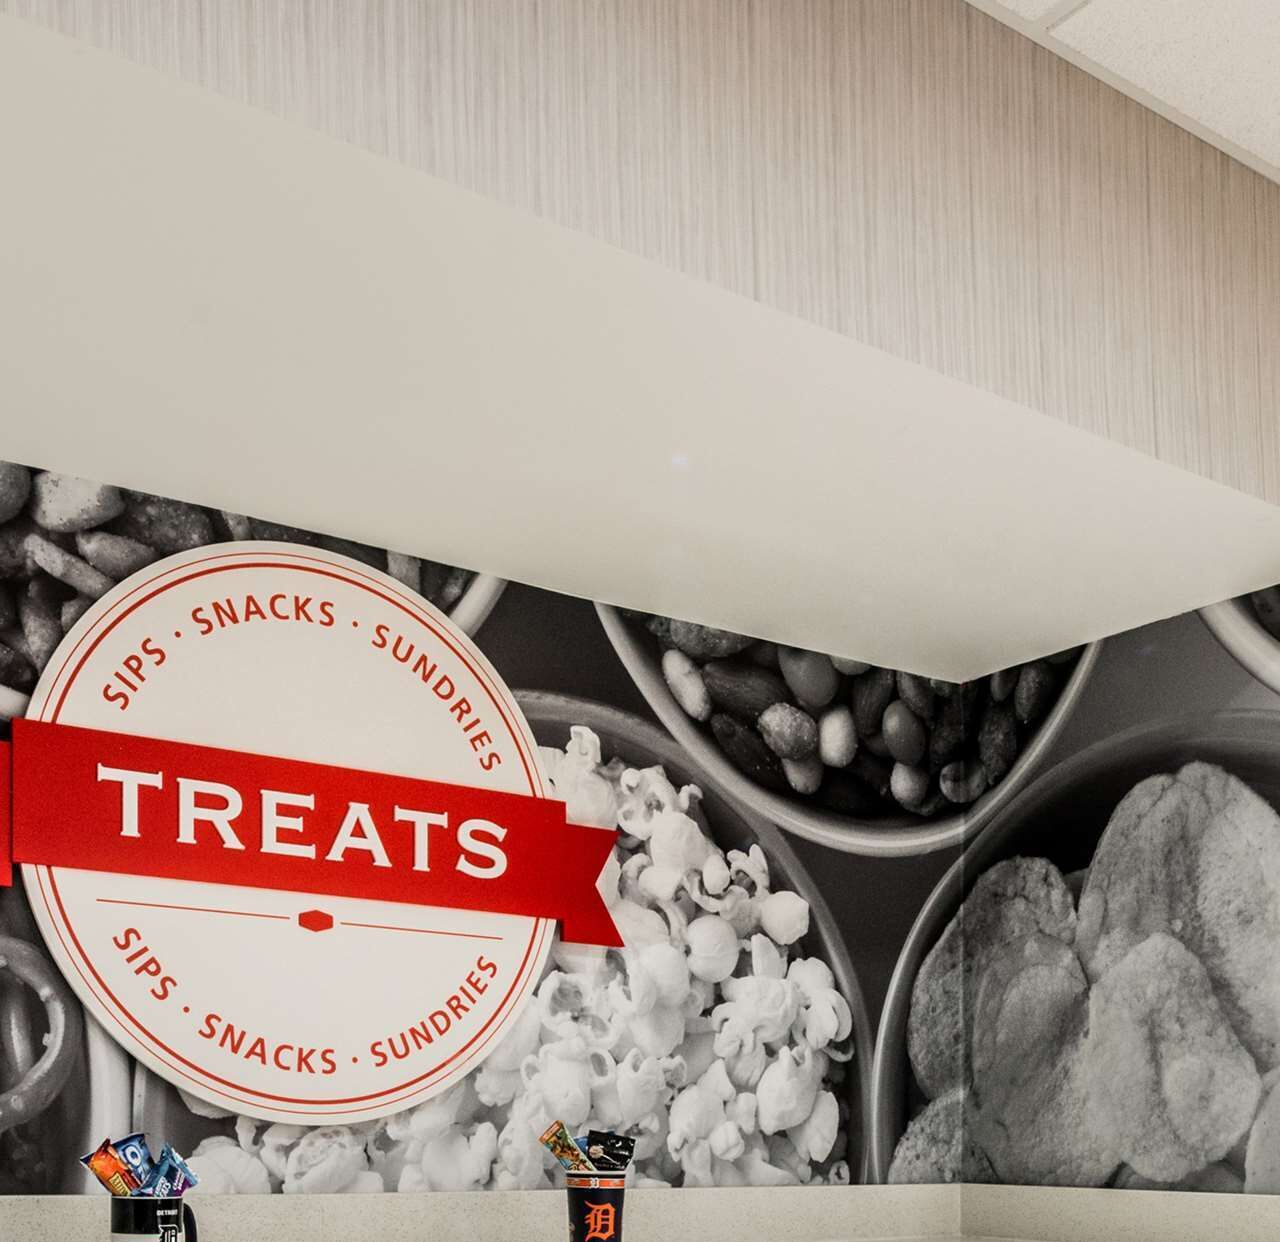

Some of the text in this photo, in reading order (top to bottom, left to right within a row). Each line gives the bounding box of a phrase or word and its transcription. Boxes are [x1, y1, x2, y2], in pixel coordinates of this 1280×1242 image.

[102, 594, 501, 772] SIPS SNACKS SUNDRIES
[97, 763, 508, 879] TREATS
[113, 927, 497, 1075] SIPS SNACKS SUNDRIES
